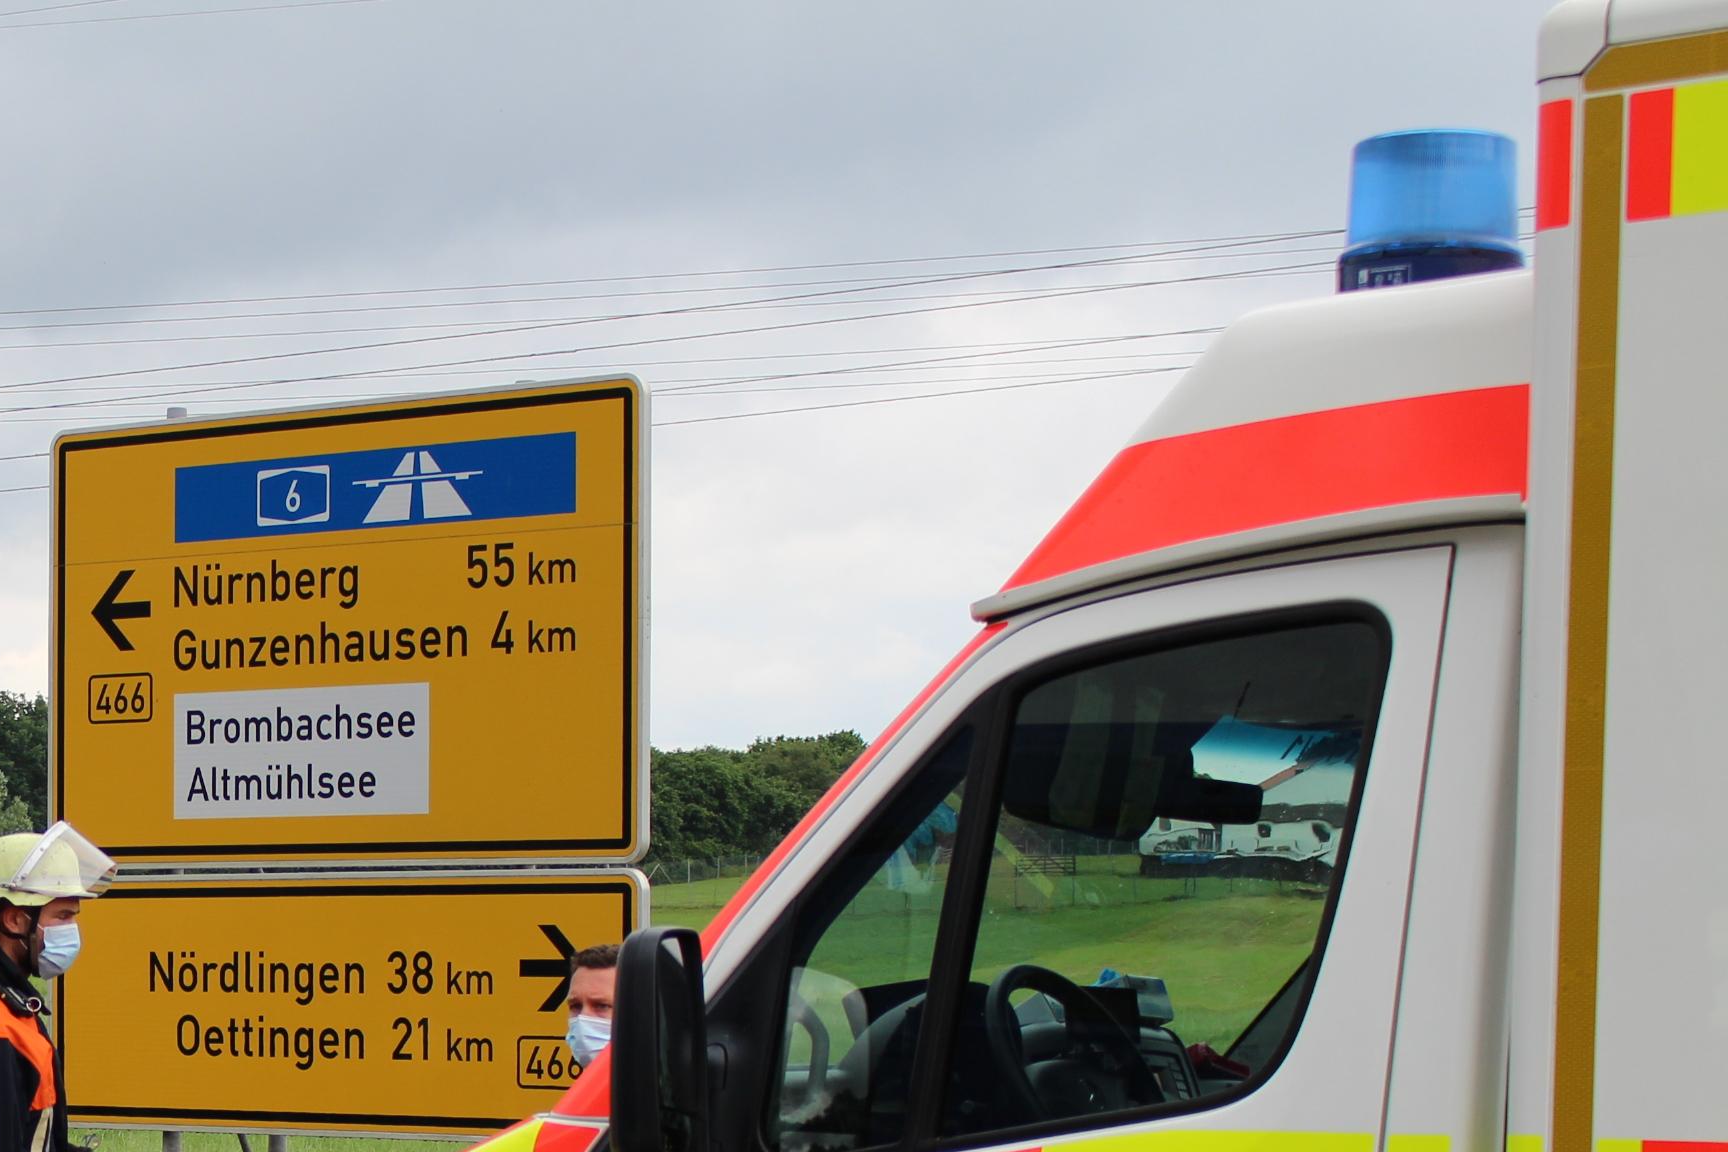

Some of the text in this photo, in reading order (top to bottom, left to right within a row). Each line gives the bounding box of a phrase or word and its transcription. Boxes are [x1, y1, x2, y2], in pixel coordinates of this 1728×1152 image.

[285, 479, 301, 513] 6
[173, 542, 576, 609] Nürnberg 55 km
[173, 610, 576, 671] Gunzenhausen 4 km
[96, 682, 145, 715] 466
[186, 704, 416, 745] Brombachsee
[187, 763, 376, 802] Altmühlsee
[149, 950, 494, 1006] Nördlingen 38 km
[176, 1014, 494, 1071] Oettingen 21 km
[525, 1045, 584, 1081] 466
